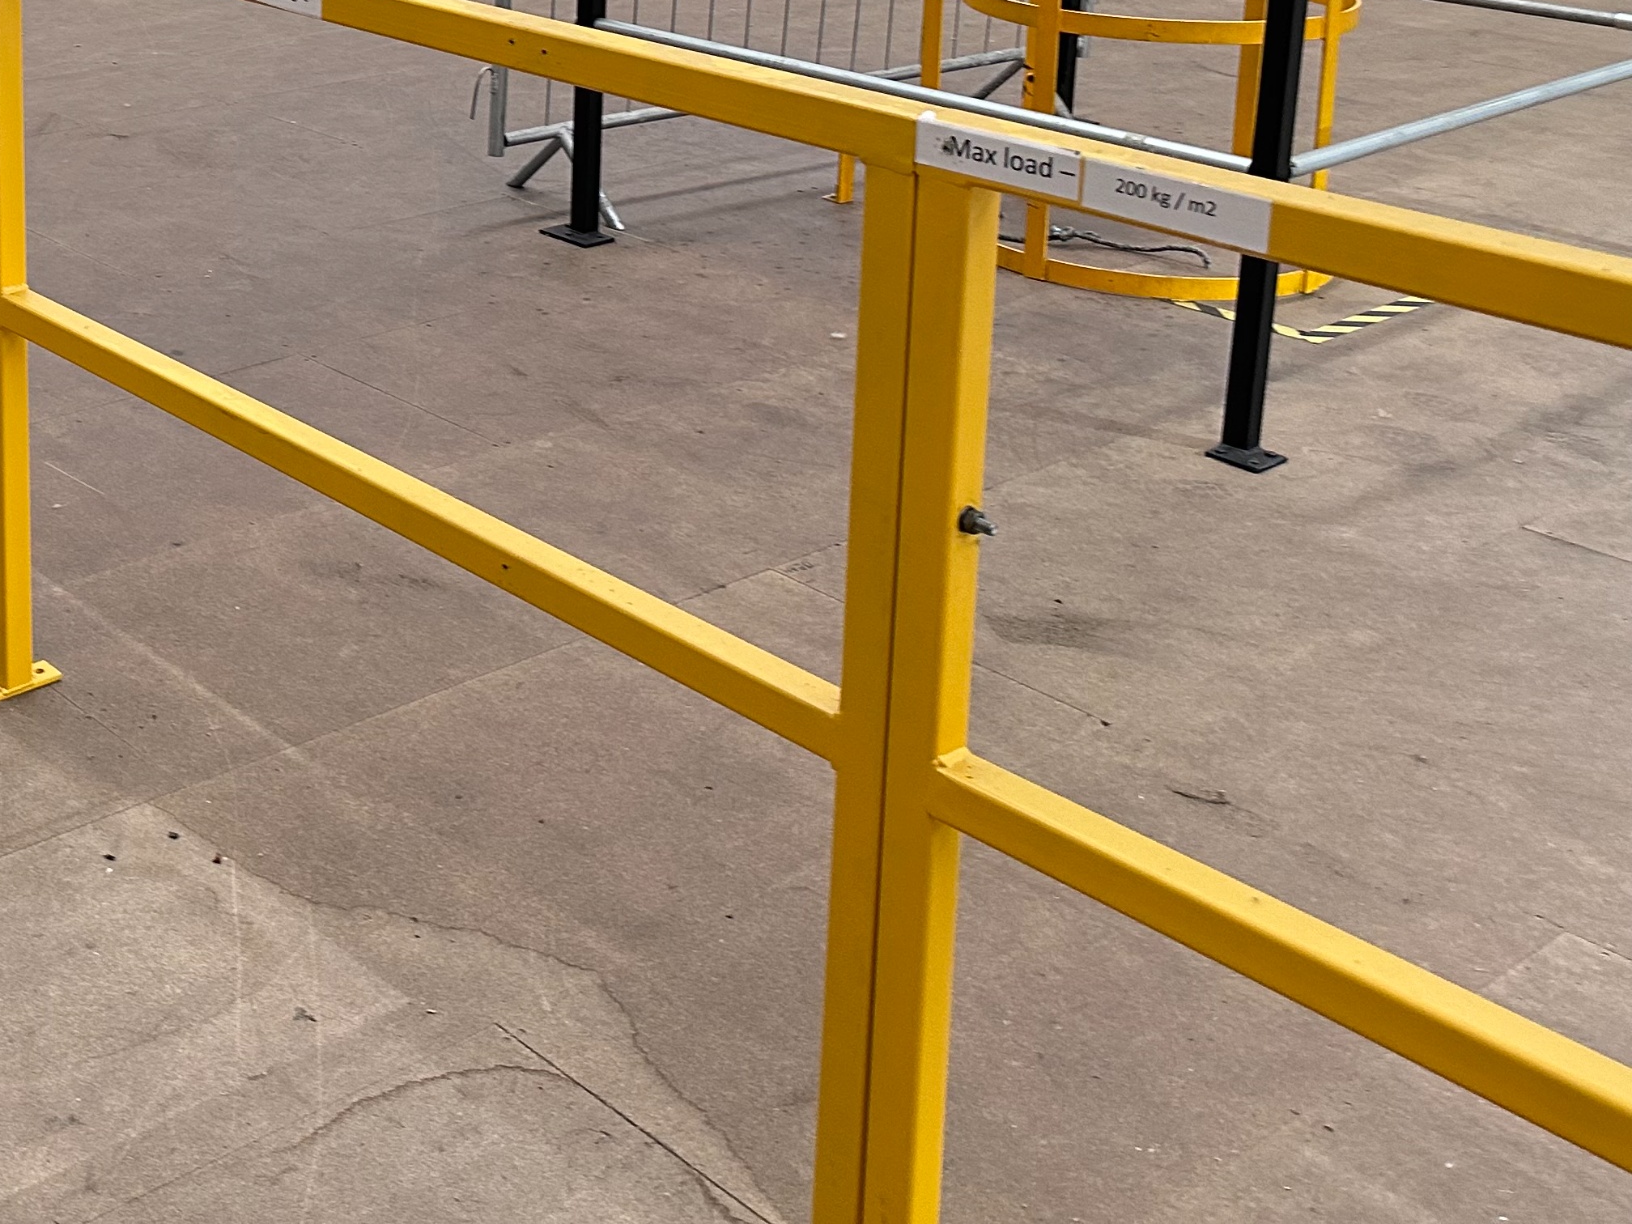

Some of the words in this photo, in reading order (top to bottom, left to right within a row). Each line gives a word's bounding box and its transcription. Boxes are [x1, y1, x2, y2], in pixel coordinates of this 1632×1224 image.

[949, 135, 997, 166] Max
[1003, 146, 1054, 179] load
[1115, 178, 1148, 199] 200
[1151, 185, 1172, 209] kg
[1173, 192, 1186, 211] /
[1187, 199, 1218, 218] m2
